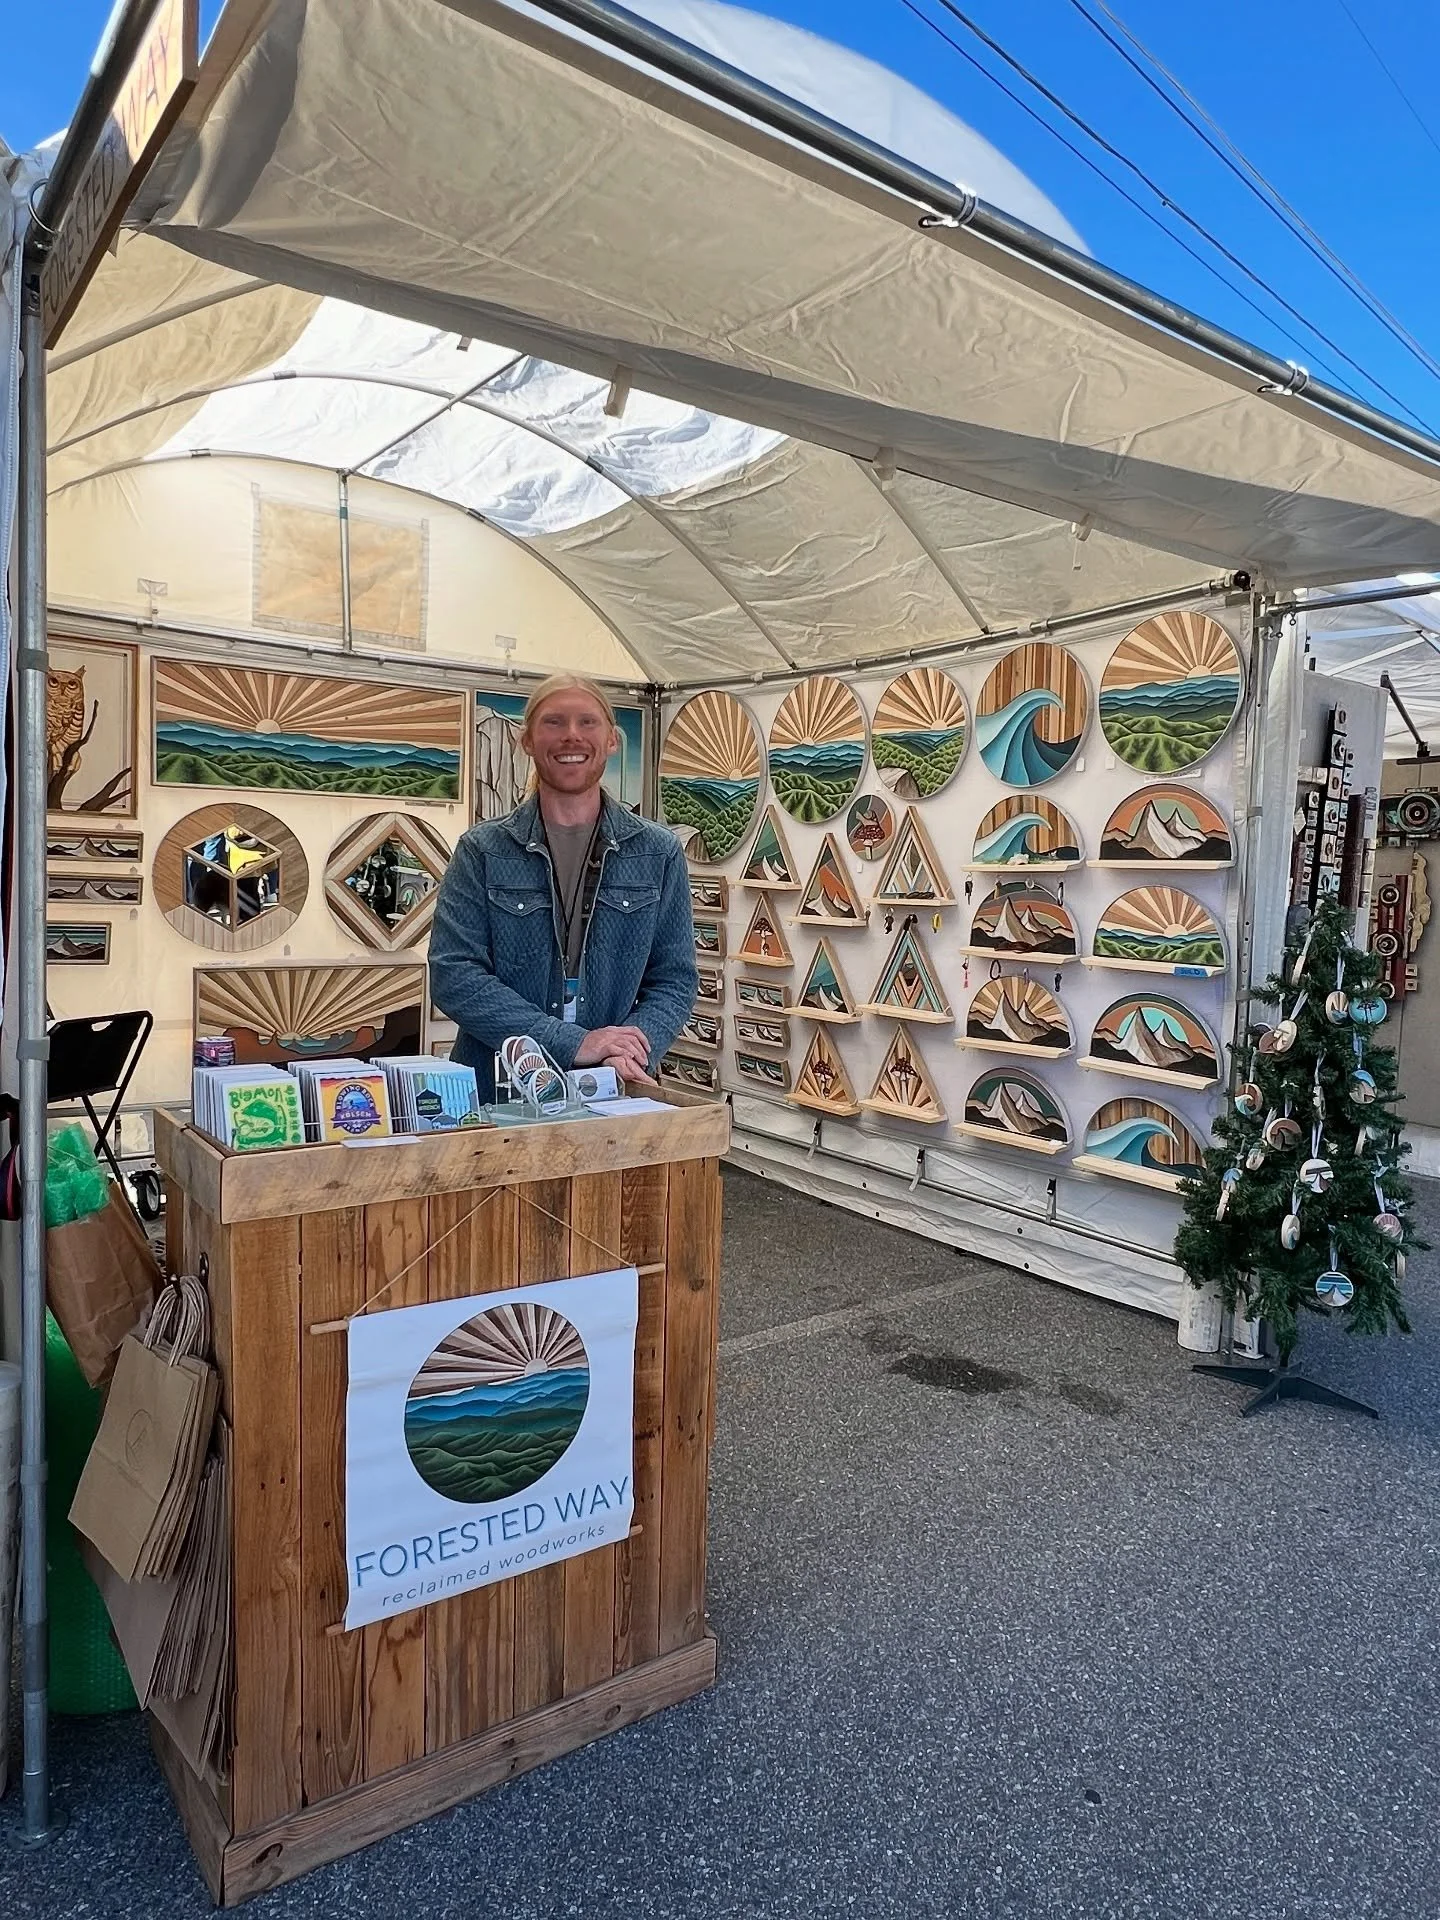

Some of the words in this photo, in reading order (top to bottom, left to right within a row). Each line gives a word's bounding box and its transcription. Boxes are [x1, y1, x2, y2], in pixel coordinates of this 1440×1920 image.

[43, 138, 115, 325] FORESTED
[336, 1085, 361, 1110] BLOWING
[361, 1088, 375, 1108] ROCK
[355, 1502, 545, 1588] FORESTED
[553, 1475, 629, 1523] WAY
[382, 1560, 490, 1607] reclaimed
[499, 1524, 606, 1570] woodworks
